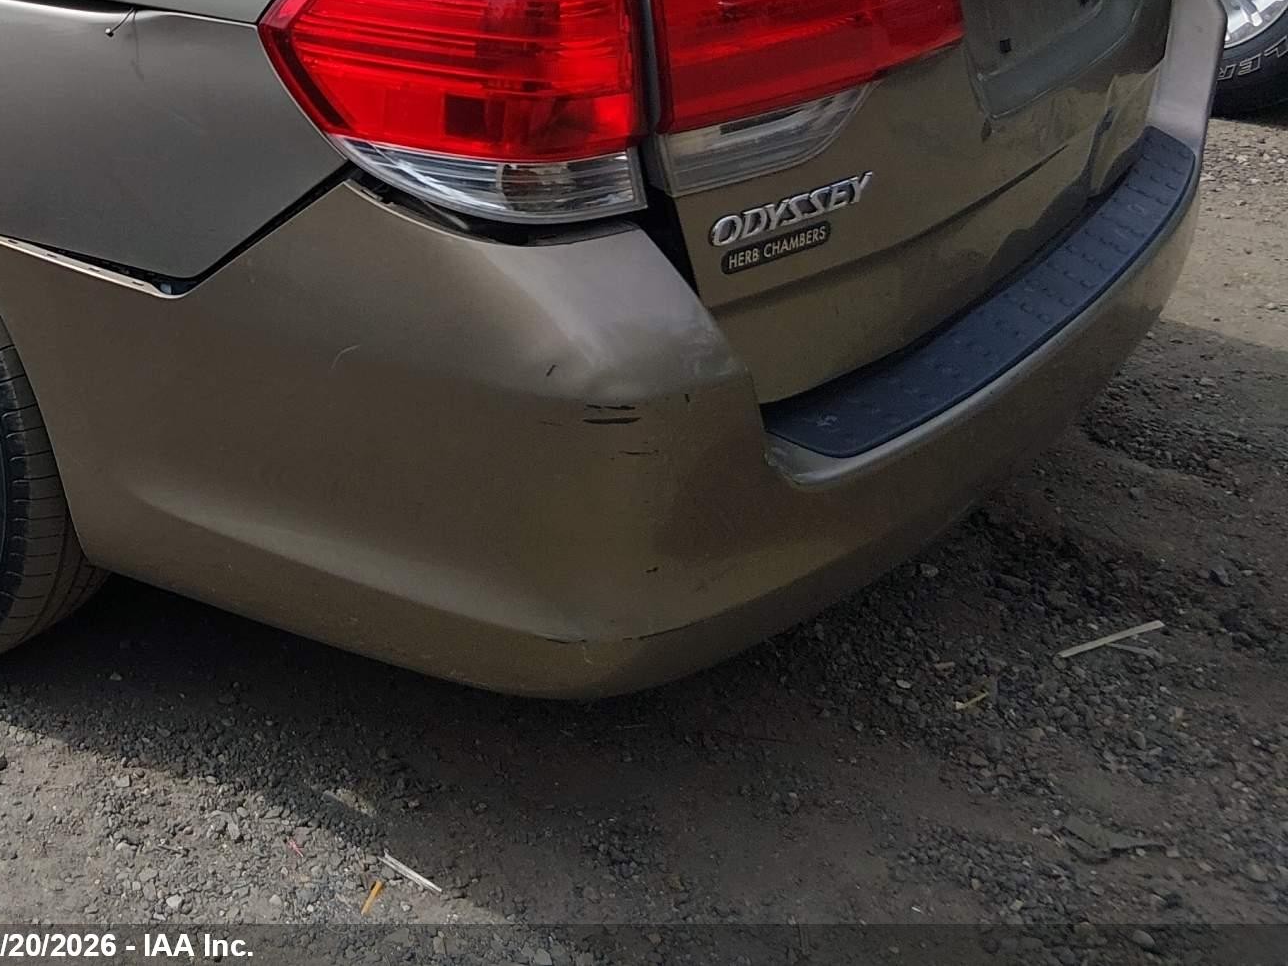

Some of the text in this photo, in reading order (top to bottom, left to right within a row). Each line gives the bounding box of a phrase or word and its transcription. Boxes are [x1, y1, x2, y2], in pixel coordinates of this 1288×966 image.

[712, 171, 873, 246] ODYSSEY
[727, 225, 827, 270] HERB CHAMBERS
